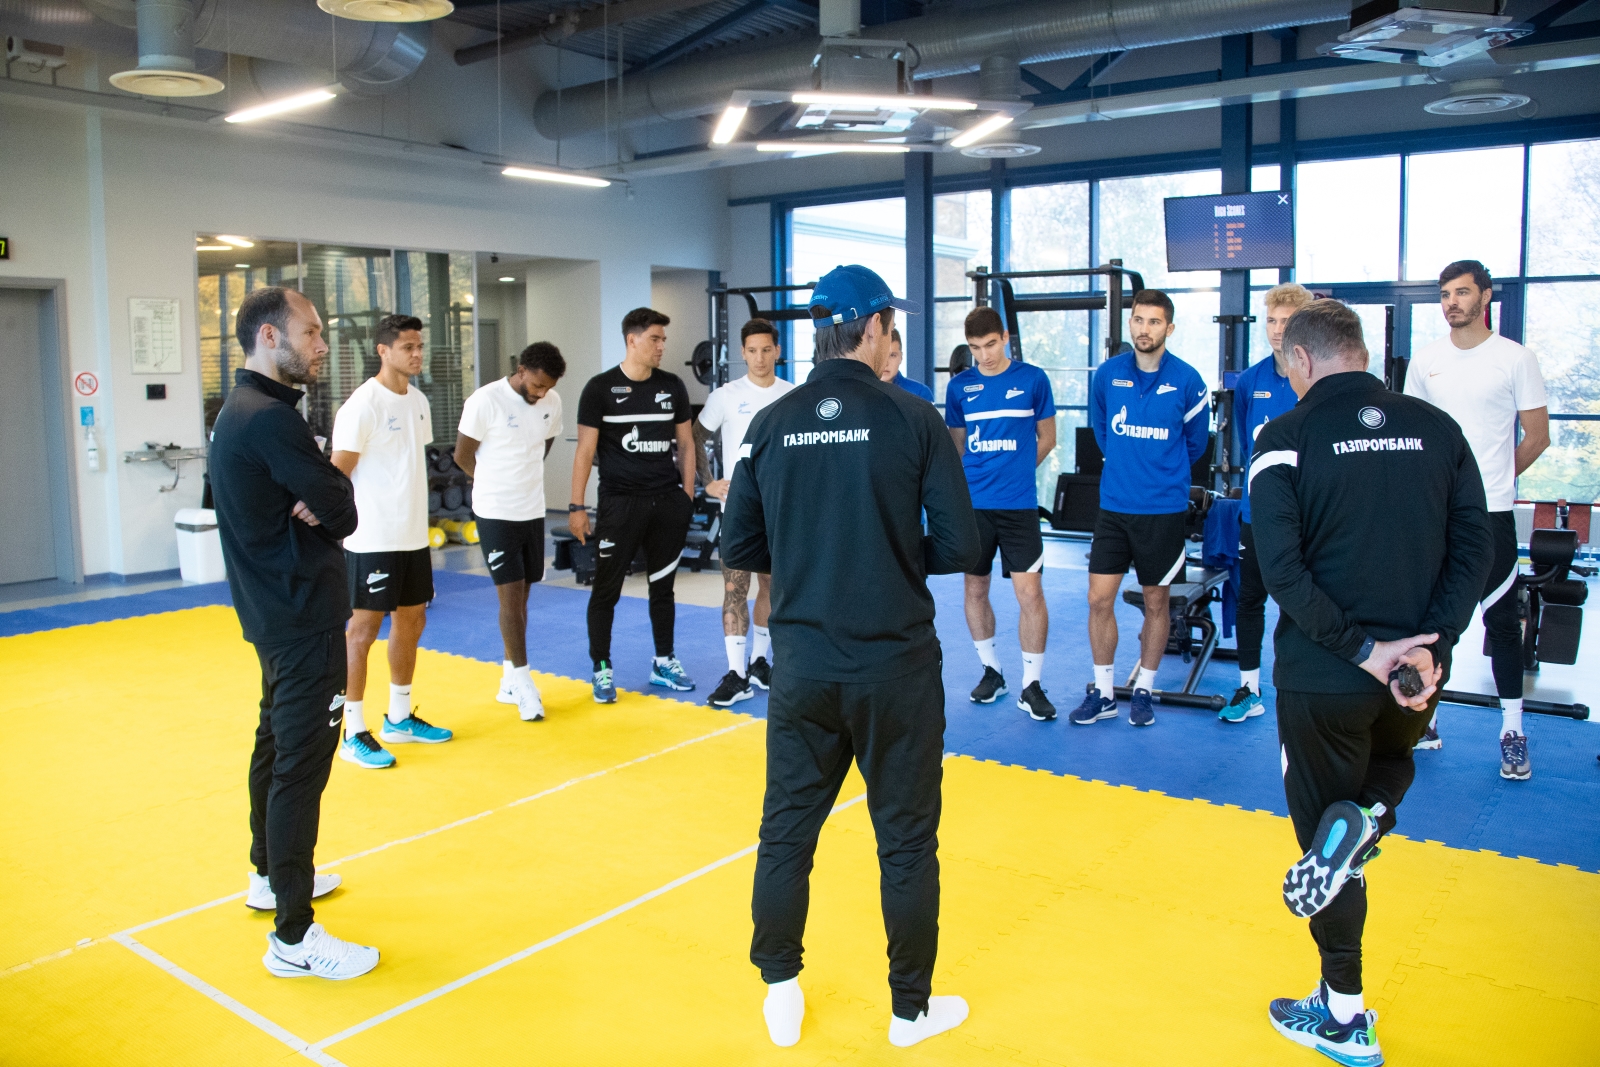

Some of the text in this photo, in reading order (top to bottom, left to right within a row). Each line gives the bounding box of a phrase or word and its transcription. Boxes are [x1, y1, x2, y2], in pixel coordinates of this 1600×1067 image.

[783, 428, 871, 448] ГАЗПРОМБАНК
[1125, 424, 1169, 440] ГАЗПРОМ
[1332, 437, 1424, 455] ГАЗПРОМБАНК
